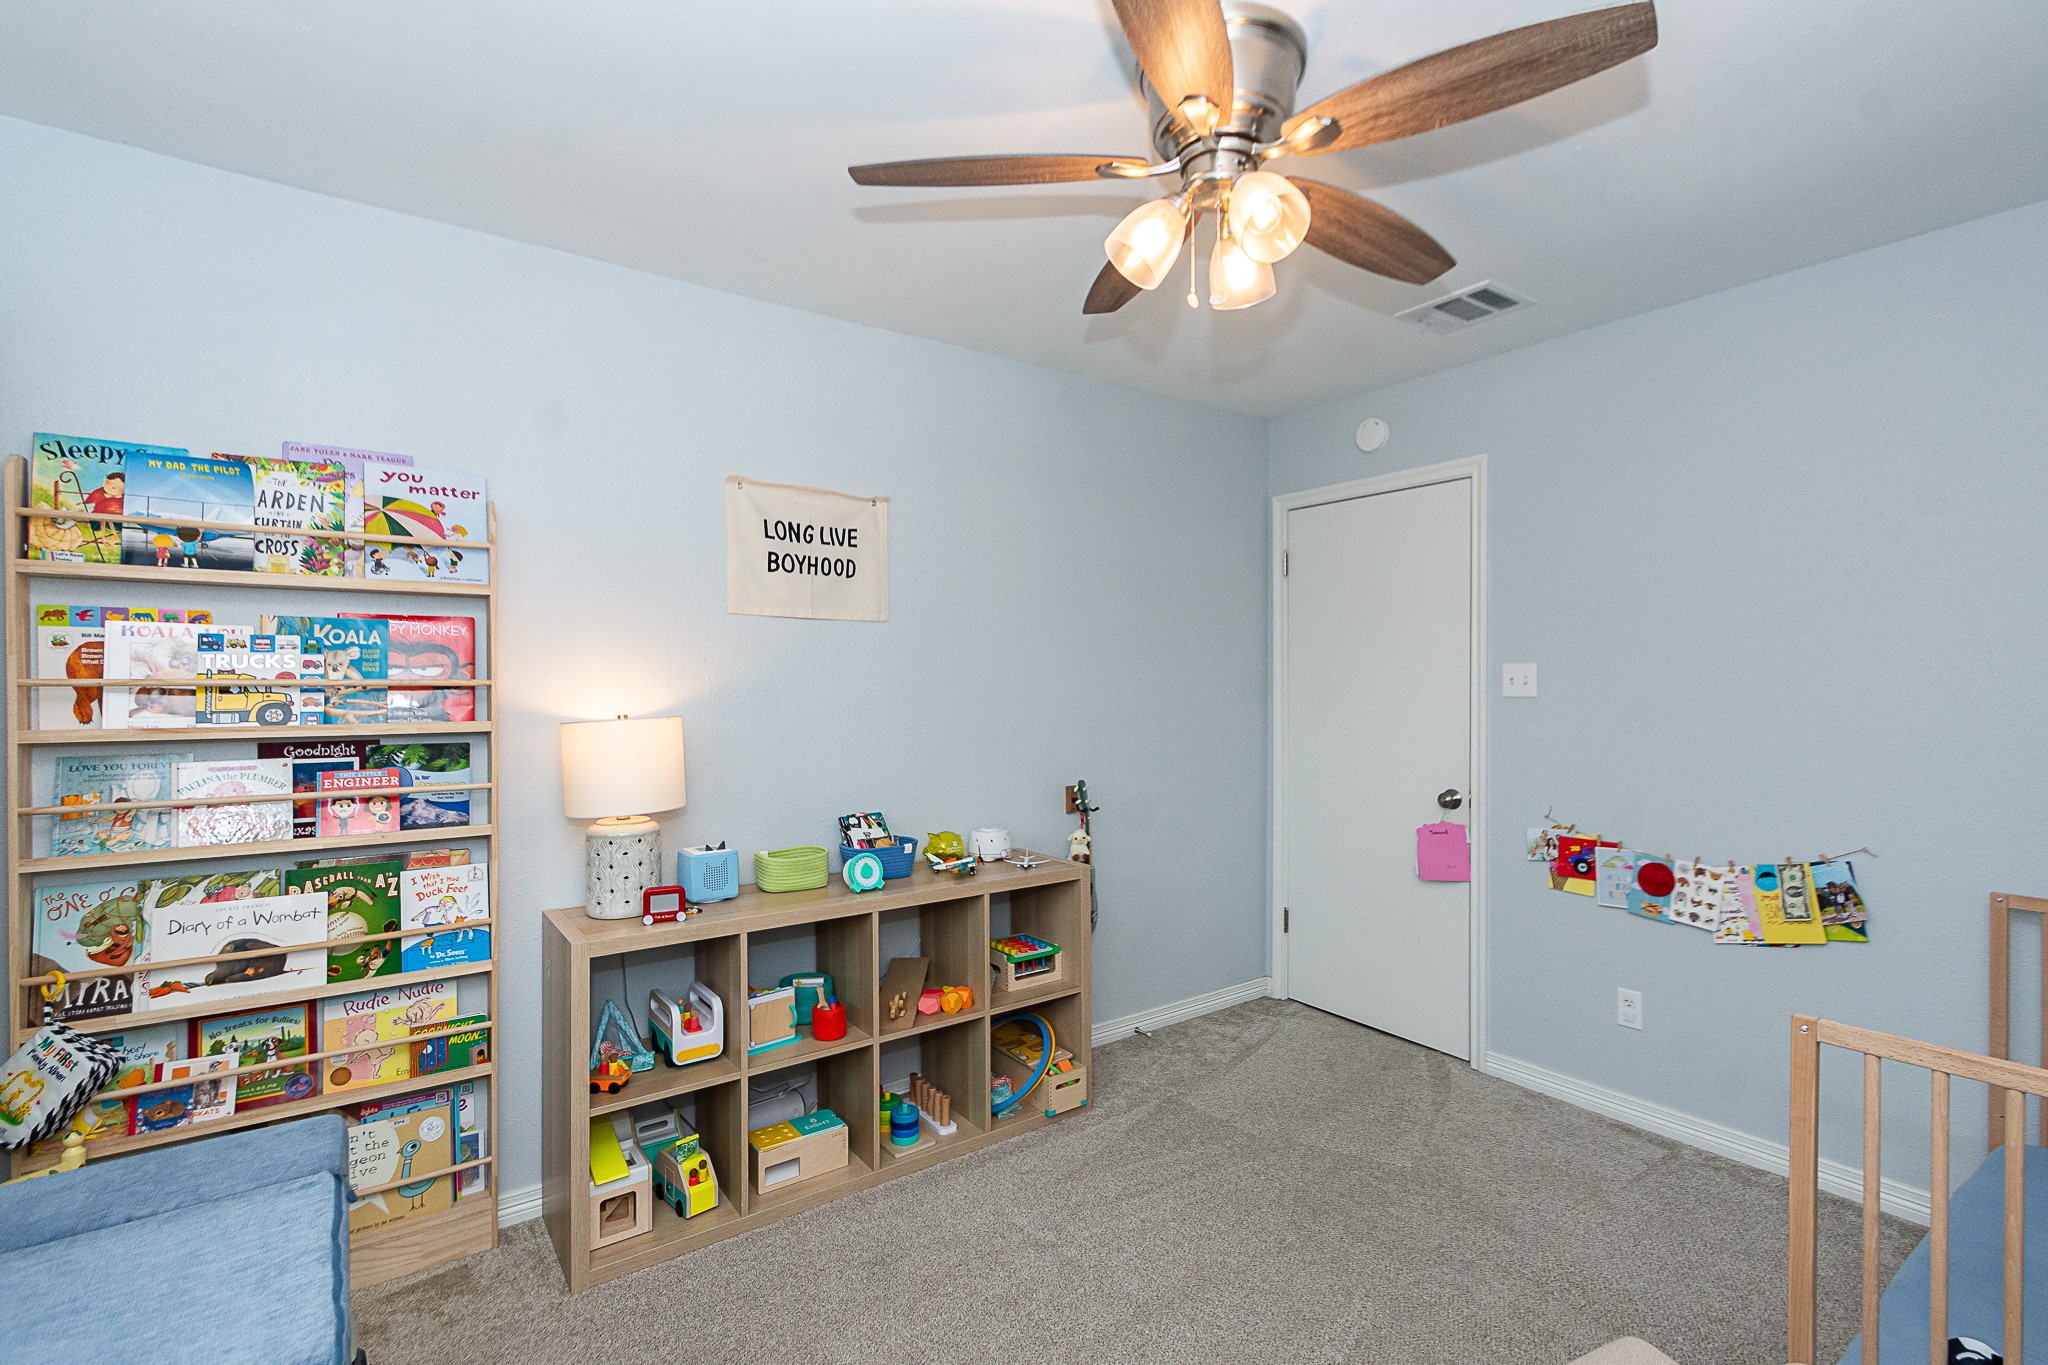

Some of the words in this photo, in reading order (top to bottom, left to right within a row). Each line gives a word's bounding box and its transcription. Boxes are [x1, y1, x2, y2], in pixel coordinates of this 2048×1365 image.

[289, 445, 311, 454] JANE
[313, 448, 341, 458] YOLEN
[350, 453, 373, 461] MARK
[376, 455, 407, 465] TEAGUE
[148, 459, 162, 469] MY
[191, 462, 210, 473] THE
[213, 465, 240, 476] PILOT
[380, 470, 423, 484] you
[409, 485, 480, 500] matter
[763, 518, 815, 545] LONG
[820, 526, 858, 548] LIVE
[254, 538, 300, 557] CROSS
[767, 551, 857, 579] BOYHOOD
[121, 625, 194, 639] KOALA
[314, 624, 382, 647] KOALA
[409, 624, 468, 637] MONKEY
[201, 653, 297, 670] TRUCKS
[283, 743, 357, 759] Goodnight
[69, 764, 100, 773] LOVE
[103, 763, 127, 771] YOU
[177, 773, 222, 796] PAULINA
[223, 772, 238, 780] the
[240, 772, 288, 791] PLUMBER
[323, 776, 400, 789] ENGINEER
[420, 872, 441, 882] Wish
[423, 880, 437, 889] that
[387, 876, 399, 898] Z
[415, 886, 443, 902] Duck
[446, 882, 468, 893] Feet
[46, 893, 92, 921] ONE
[242, 902, 271, 910] FRENCH
[166, 919, 212, 936] Diary
[216, 915, 233, 930] of
[237, 917, 247, 926] a
[252, 906, 322, 926] Wombat
[343, 992, 391, 1016] Rudie
[398, 981, 444, 1001] Nudie
[208, 1030, 222, 1040] No
[223, 1020, 253, 1033] Treats
[255, 1016, 270, 1025] for
[271, 1015, 302, 1025] Bullies!
[37, 1035, 57, 1057] My
[448, 1030, 482, 1046] MOON
[804, 1119, 830, 1130] EIGHT
[365, 1139, 390, 1152] the
[350, 1151, 387, 1169] geon
[351, 1165, 378, 1180] ive
